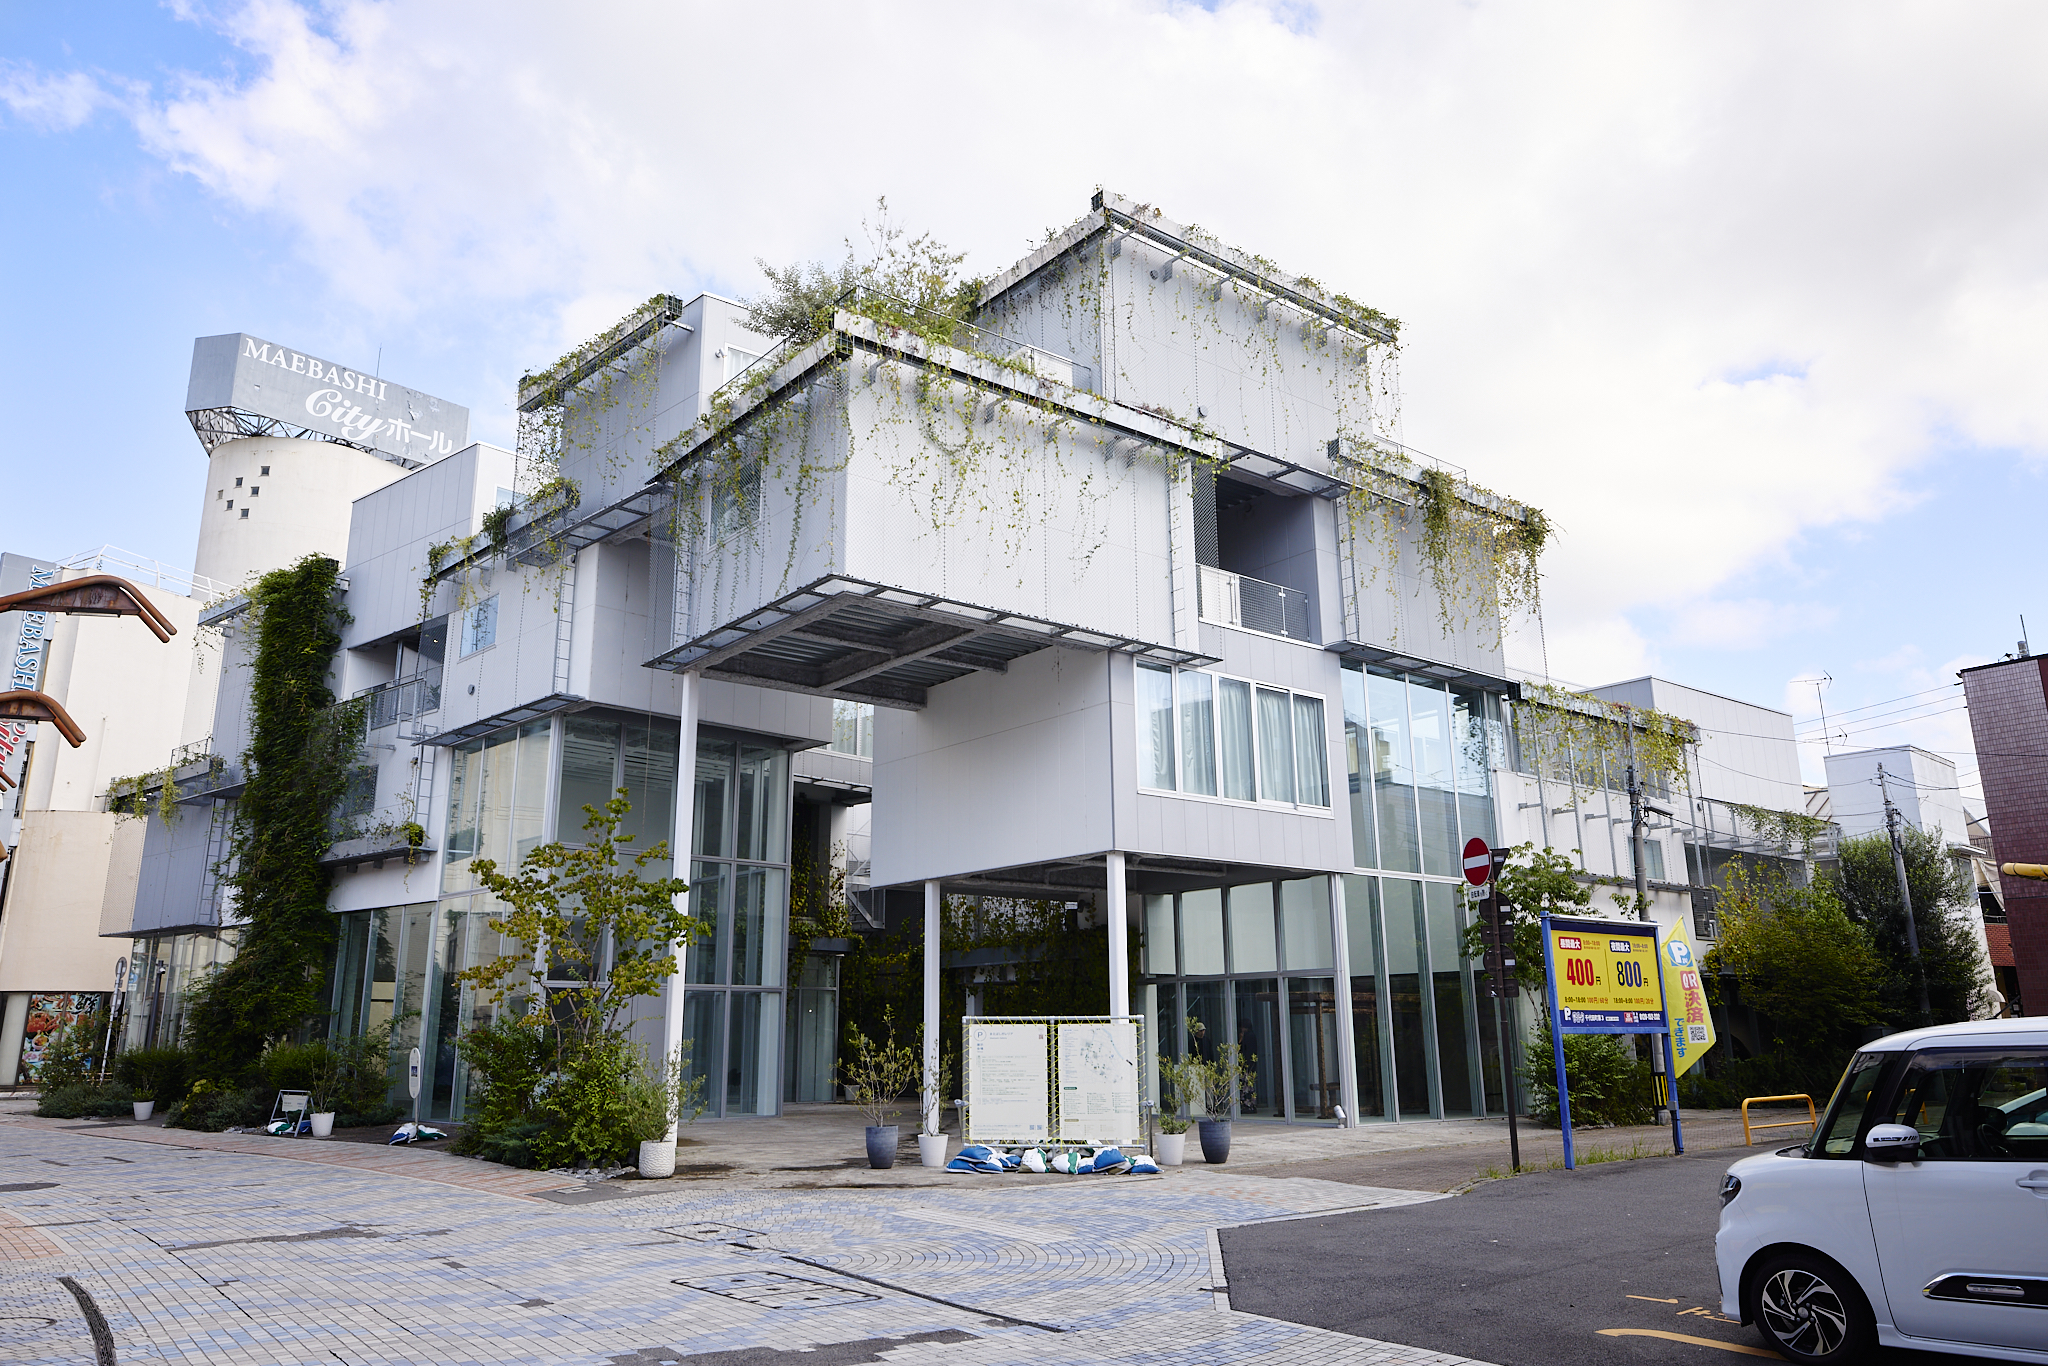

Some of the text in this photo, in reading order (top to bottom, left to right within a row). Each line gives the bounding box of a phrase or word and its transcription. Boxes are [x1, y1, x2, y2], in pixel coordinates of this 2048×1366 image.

[243, 337, 388, 401] MAEBASHI
[12, 565, 55, 691] MEBASH
[1674, 1018, 1687, 1058] できます
